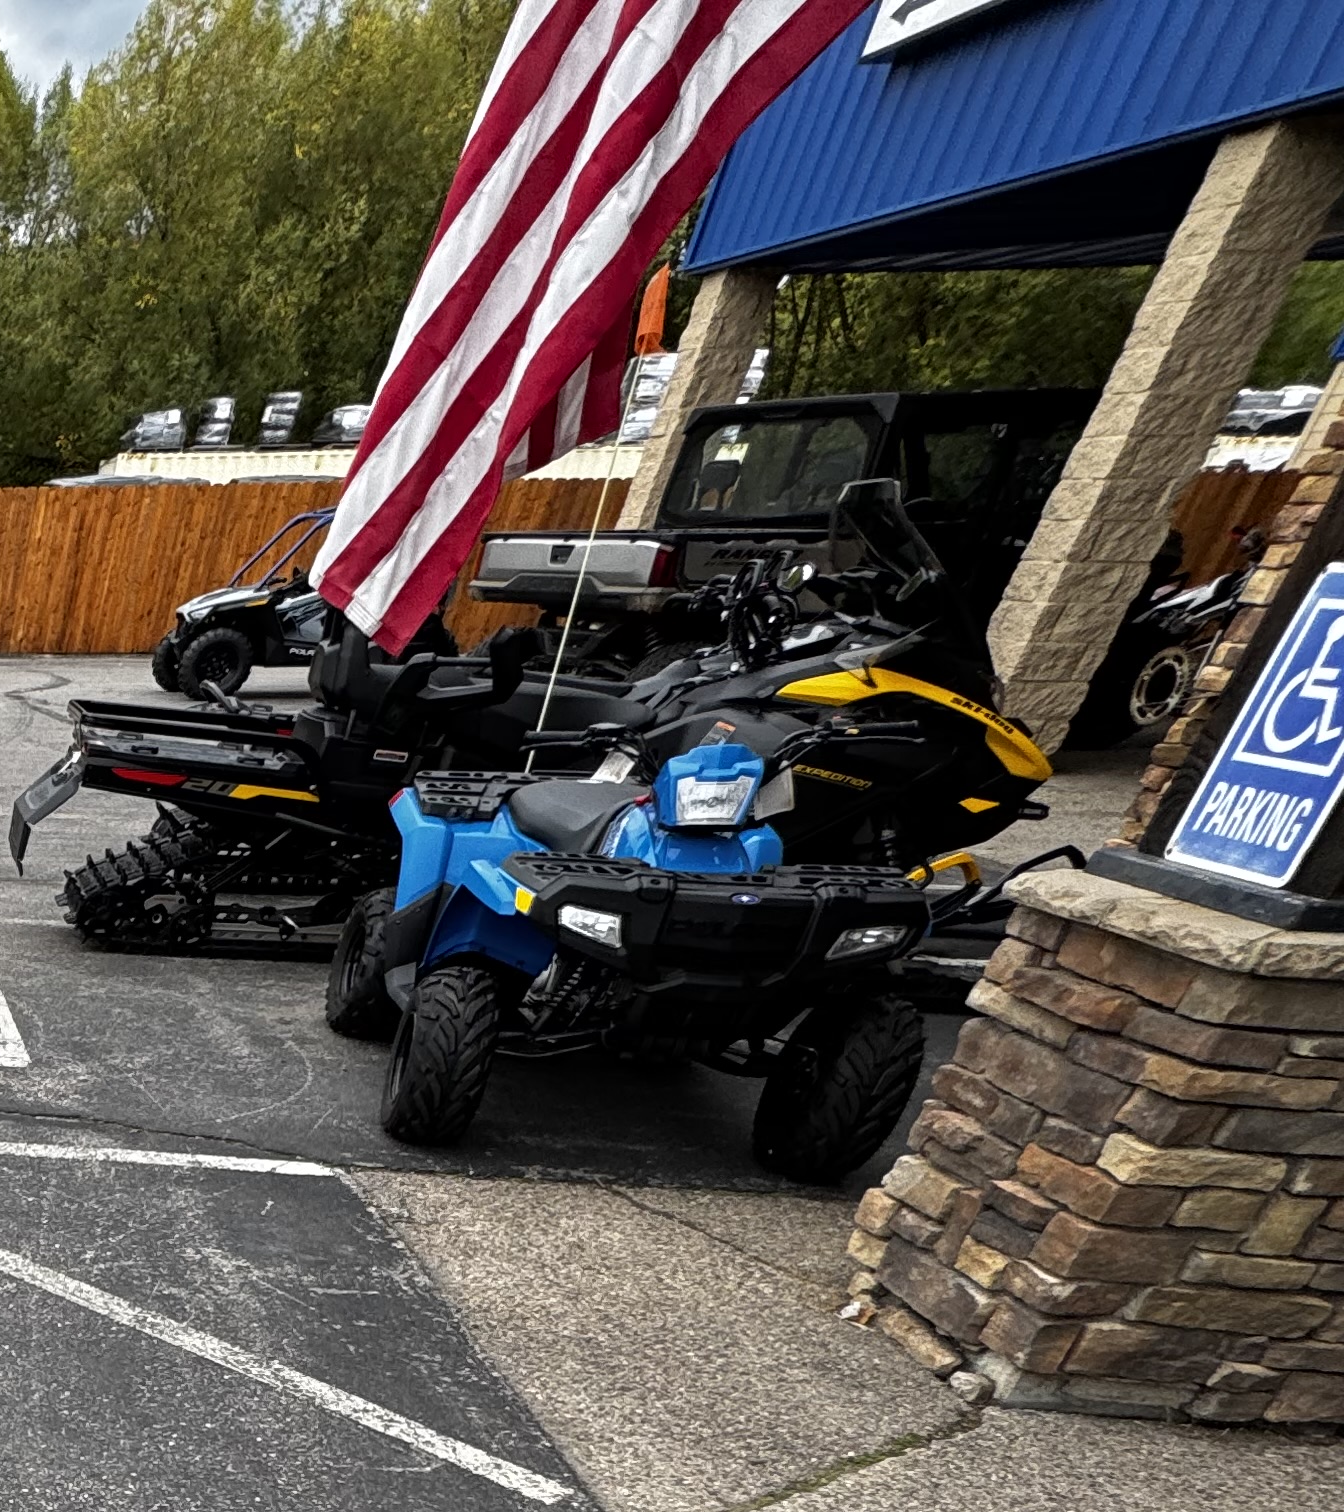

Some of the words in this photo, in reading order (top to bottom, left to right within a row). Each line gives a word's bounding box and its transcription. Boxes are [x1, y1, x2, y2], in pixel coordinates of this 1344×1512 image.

[180, 777, 238, 797] 20
[792, 764, 873, 788] EXPEDITION
[1192, 781, 1313, 851] PARKING
